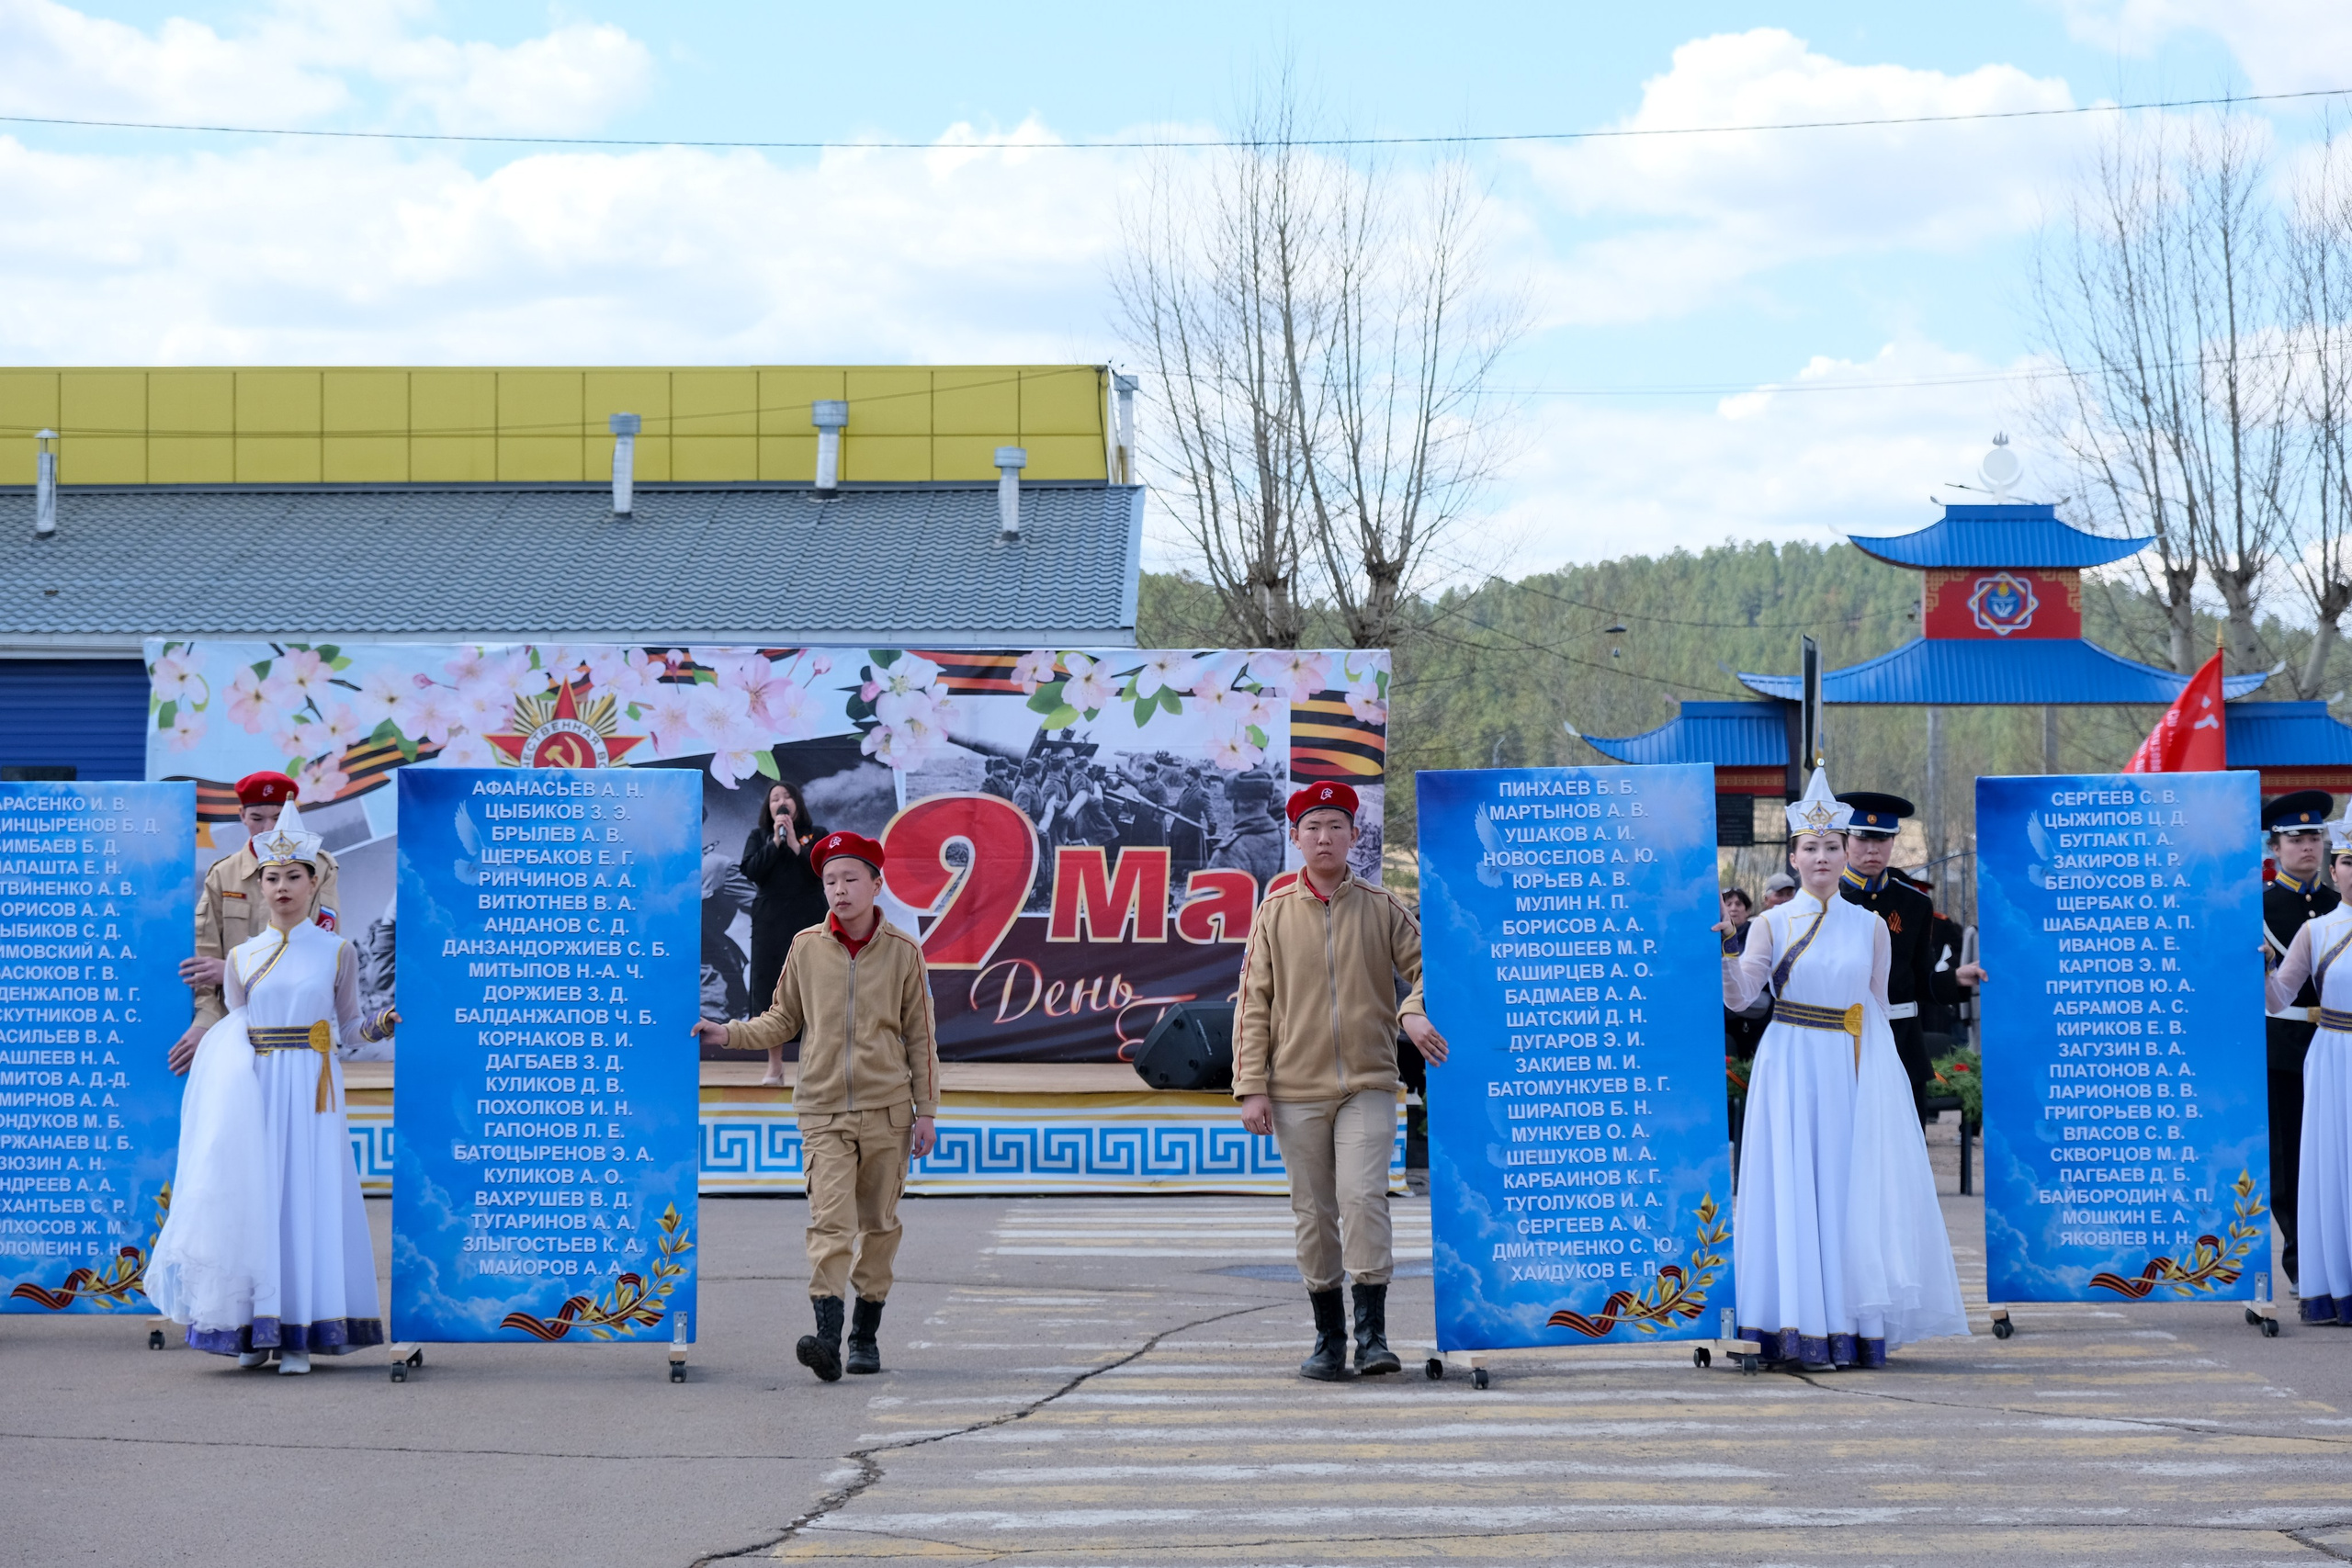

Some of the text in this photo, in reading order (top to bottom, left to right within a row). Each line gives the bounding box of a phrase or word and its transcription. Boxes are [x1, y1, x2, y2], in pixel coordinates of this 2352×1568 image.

[472, 781, 645, 799] АФАНАСЬЕВ А. Н.
[1499, 779, 1639, 798] ПИНХАЕВ Б. Б.
[492, 826, 625, 843] БРЫЛЕВ А. В.
[97, 881, 115, 896] А.
[120, 881, 137, 897] В.
[880, 791, 1297, 970] 9 Ма
[1513, 871, 1631, 889] ЮРЬЕВ А. В.
[479, 894, 637, 911] ВИТЮТНЕВ В. А.
[1517, 893, 1630, 912] МУЛИН Н. П.
[2057, 893, 2181, 914] ЩЕРБАК О. И.
[83, 922, 100, 939] С.
[104, 923, 122, 942] Д.
[484, 917, 630, 937] АНДАНОВ С. Д.
[1503, 916, 1645, 936] БОРИСОВ А. А.
[2043, 914, 2196, 934] ШАБАДАЕВ А. П.
[442, 940, 671, 959] ДАНЗАНДОРЖИЕВ С. Б.
[1491, 939, 1658, 959] КРИВОШЕЕВ М. Р.
[2059, 935, 2181, 953] ИВАНОВ А. Е.
[0, 965, 119, 981] АСЮКОВ Г. В.
[469, 963, 644, 979] МИТЫПОВ Н.-А. Ч.
[1498, 962, 1654, 983] КАШИРЦЕВ А. О.
[2059, 956, 2181, 974] КАРПОВ Э. М.
[105, 987, 124, 1002] М.
[129, 987, 141, 1002] Г.
[969, 958, 1142, 1024] День
[2046, 977, 2196, 995] ПРИТУПОВ Ю. А.
[483, 986, 628, 1005] ДОРЖИЕВ З. Д.
[1506, 985, 1647, 1007] БАДМАЕВ А. А.
[2053, 998, 2189, 1016] АБРАМОВ А. С.
[456, 1008, 658, 1027] БАЛДАНЖАПОВ Ч. Б.
[1507, 1006, 1647, 1028] ШАТСКИЙ Д. Н.
[2057, 1020, 2188, 1037] КИРИКОВ Е. В.
[479, 1031, 634, 1048] КОРНАКОВ В. И.
[1510, 1031, 1645, 1054] ДУГАРОВ Э. И.
[81, 1050, 98, 1066] Н.
[103, 1050, 120, 1066] А.
[2059, 1041, 2187, 1058] ЗАГУЗИН В. А.
[486, 1054, 625, 1074] ДАГБАЕВ З. Д.
[1516, 1054, 1642, 1074] ЗАКИЕВ М. И.
[2050, 1061, 2197, 1078] ПЛАТОНОВ А. А.
[68, 1071, 85, 1087] А.
[89, 1071, 130, 1089] Д.-Д.
[487, 1077, 625, 1096] КУЛИКОВ Д. В.
[1488, 1076, 1671, 1098] БАТОМУНКУЕВ В. Г.
[80, 1092, 97, 1108] А.
[102, 1092, 119, 1108] А.
[2049, 1082, 2198, 1100] ЛАРИОНОВ В. В.
[477, 1100, 633, 1116] ПОХОЛКОВ И. Н.
[1508, 1099, 1653, 1120] ШИРАПОВ Б. Н.
[2045, 1103, 2204, 1121] ГРИГОРЬЕВ Ю. В.
[485, 1122, 626, 1139] ГАПОНОВ Л. Е.
[1512, 1122, 1650, 1143] МУНКУЕВ О. А.
[2064, 1124, 2186, 1142] ВЛАСОВ С. В.
[96, 1134, 112, 1153] Ц.
[118, 1134, 134, 1150] Б.
[66, 1156, 85, 1171] А.
[89, 1156, 107, 1171] Н.
[76, 1177, 94, 1192] А.
[98, 1177, 117, 1192] А.
